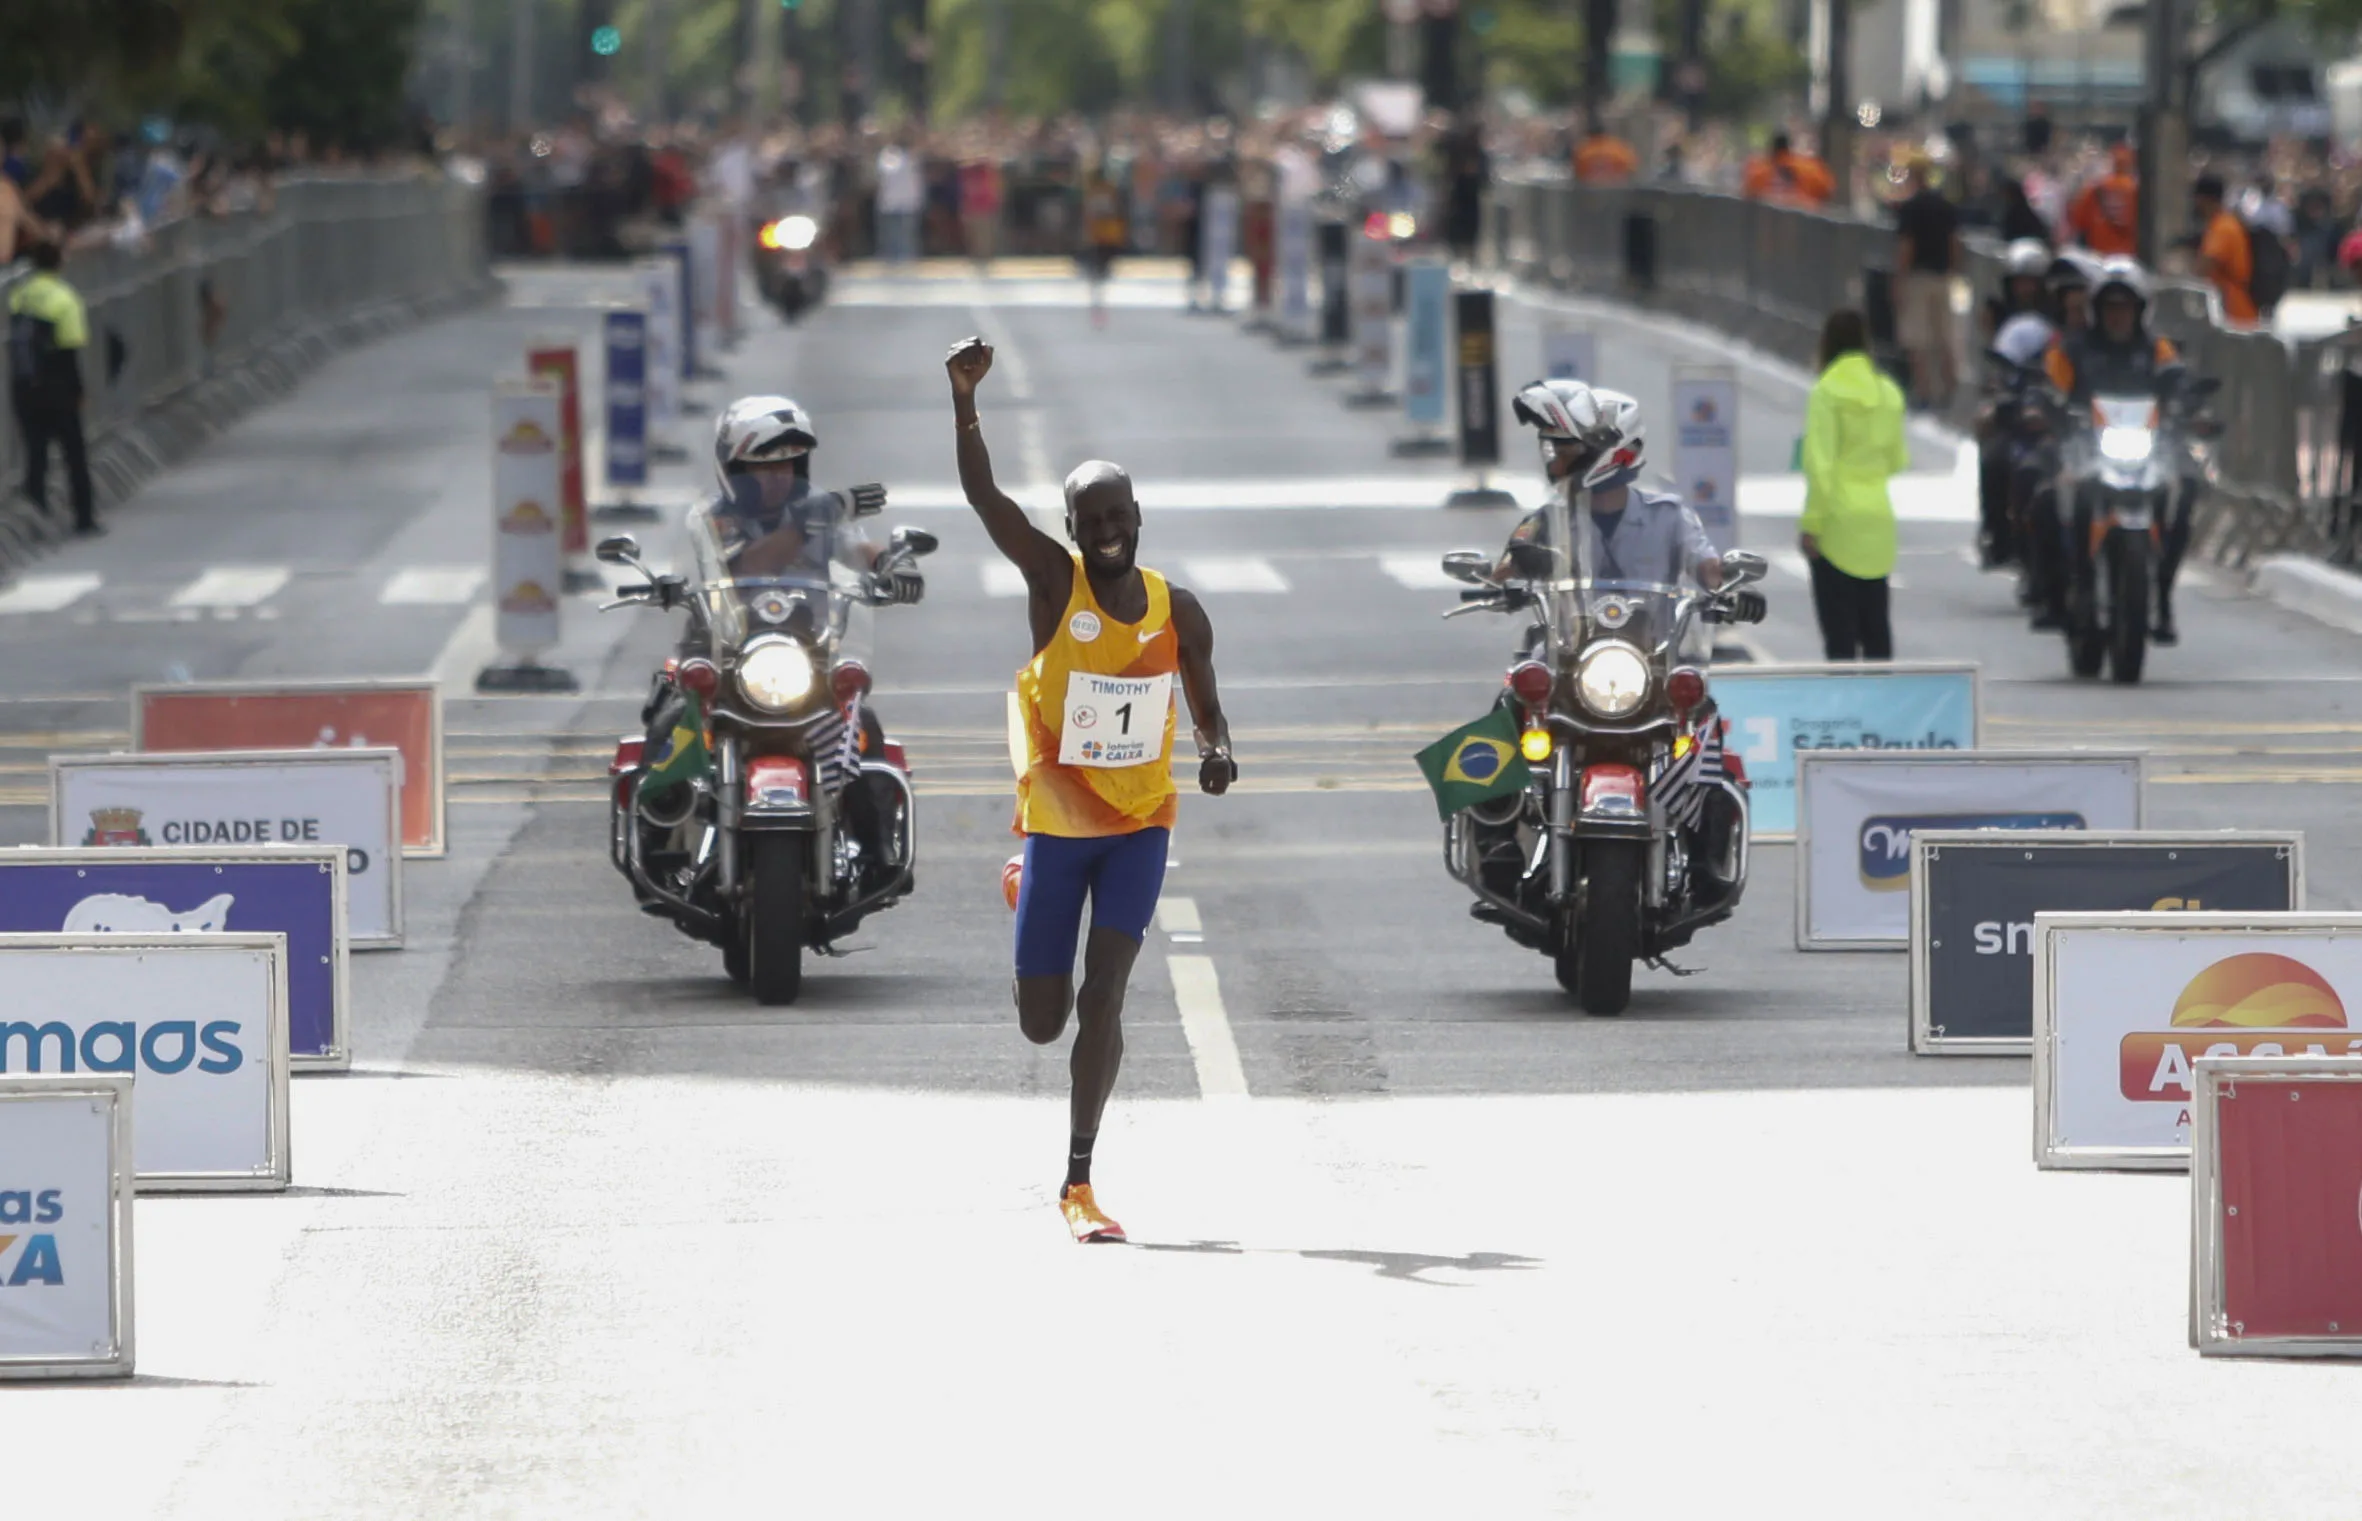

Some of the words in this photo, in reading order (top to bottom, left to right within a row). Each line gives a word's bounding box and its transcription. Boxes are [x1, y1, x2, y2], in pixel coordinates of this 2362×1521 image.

[1091, 680, 1152, 695] TIMOTHY
[1115, 702, 1132, 735] 1
[1106, 750, 1143, 761] CAIXA
[162, 820, 271, 844] CIDADE
[281, 819, 320, 841] DE
